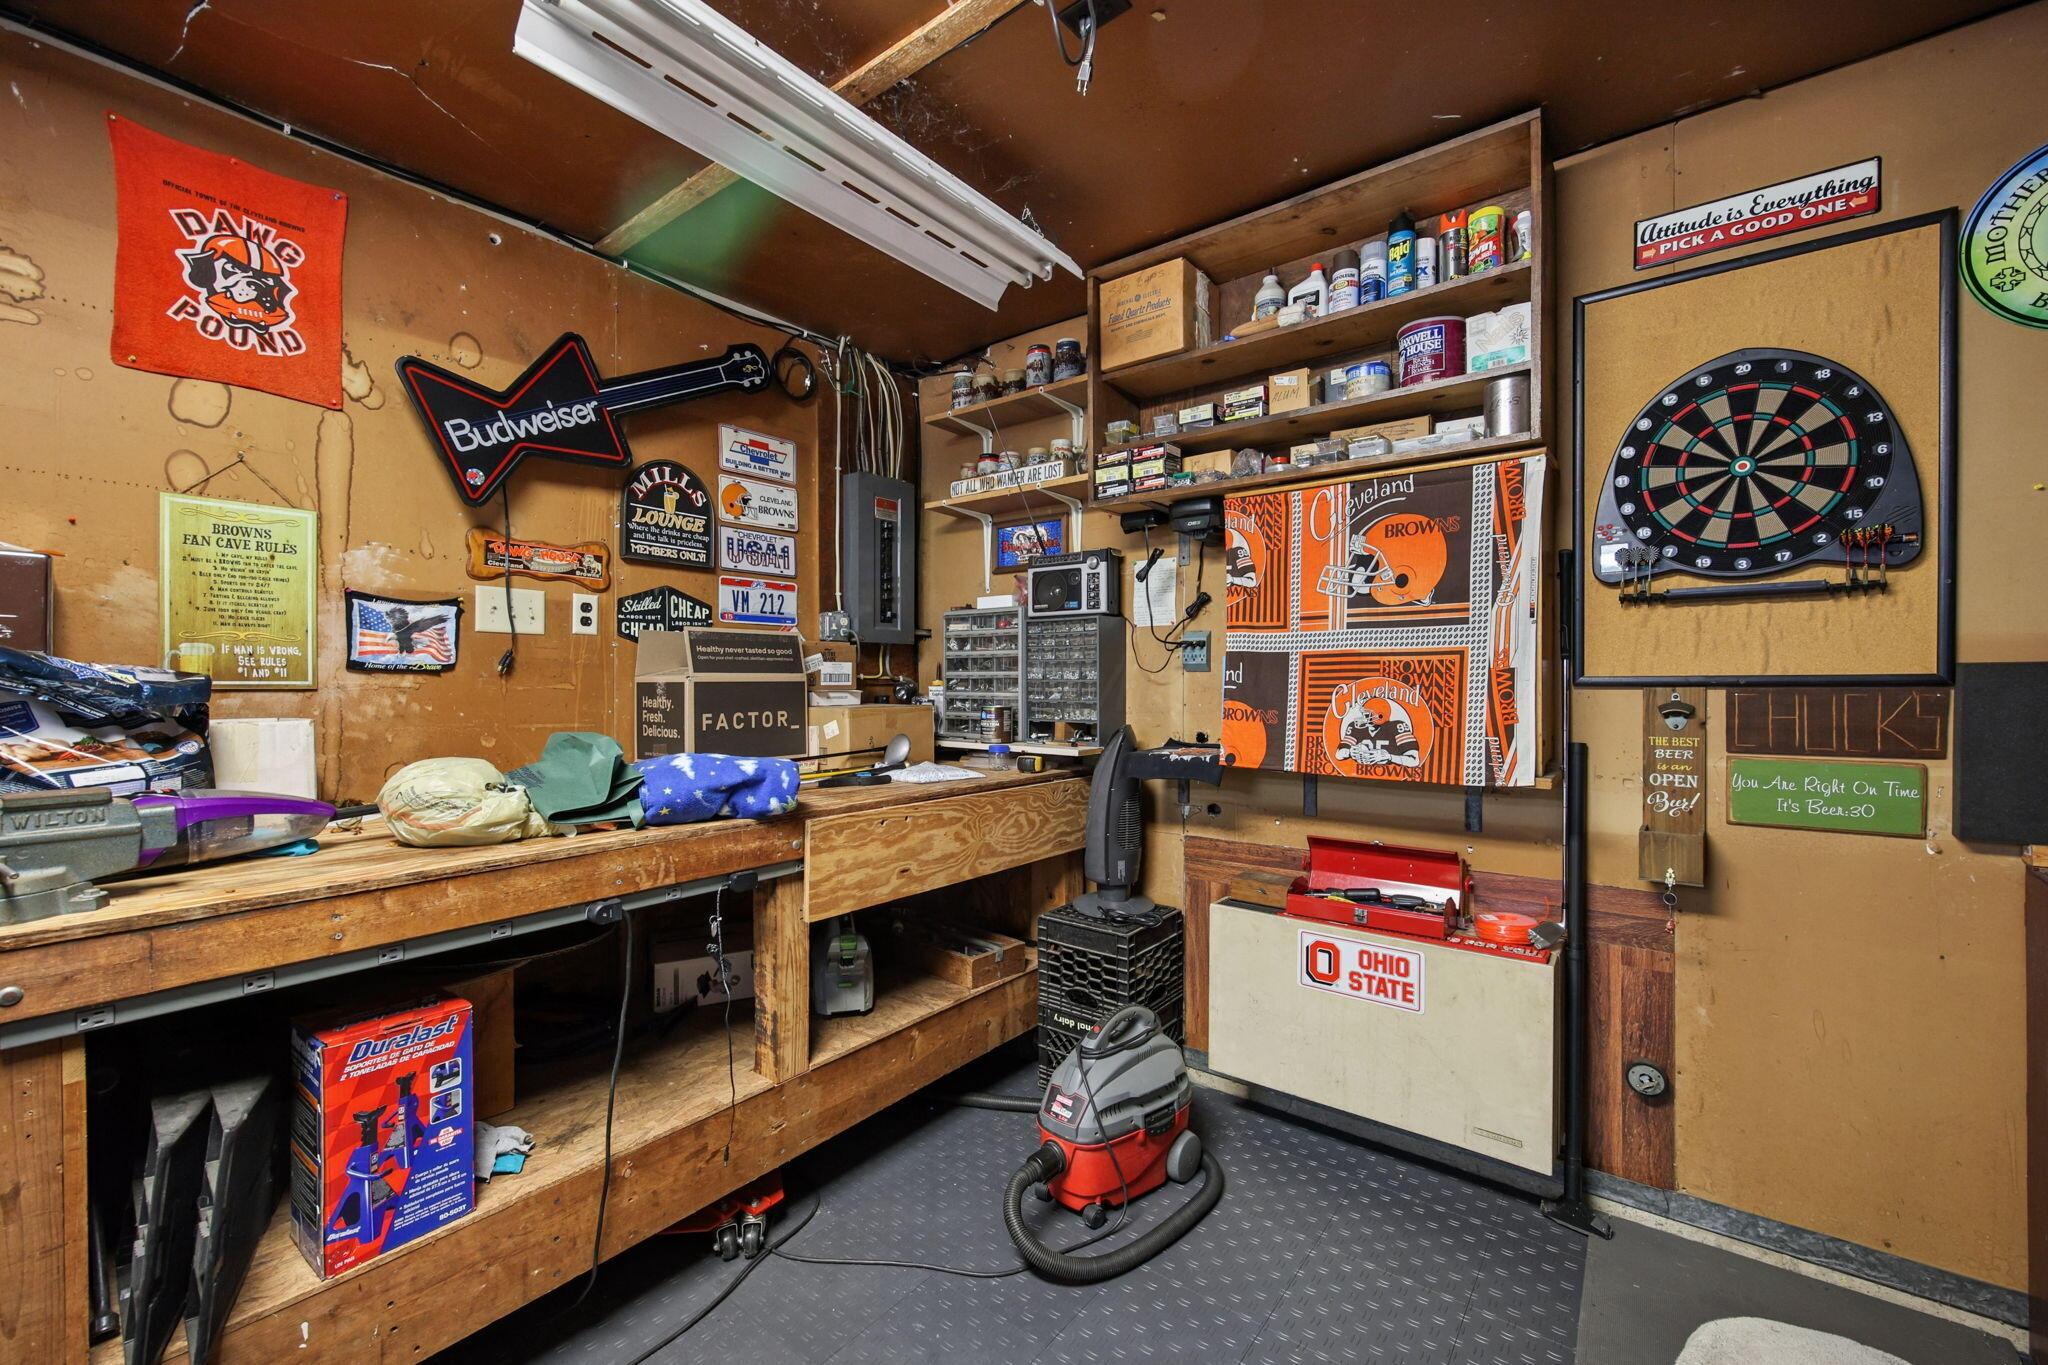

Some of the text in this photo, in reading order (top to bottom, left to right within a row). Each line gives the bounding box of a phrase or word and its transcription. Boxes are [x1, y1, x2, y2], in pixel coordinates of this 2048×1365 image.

[1640, 175, 1875, 244] Attitude is Everything
[1660, 199, 1846, 254] PICK A GOOD ONE
[171, 208, 304, 267] DAWG
[1389, 240, 1410, 261] Raid
[1146, 297, 1171, 312] Products
[168, 297, 305, 356] POUND
[1407, 340, 1441, 356] HOUSE
[1736, 363, 1751, 373] 20
[1781, 362, 1788, 371] 1
[1815, 369, 1831, 379] 18
[1700, 377, 1709, 386] 5
[1849, 387, 1859, 396] 4
[1663, 395, 1677, 405] 12
[1640, 420, 1648, 429] 9
[1867, 412, 1883, 422] 13
[444, 400, 598, 452] Budweiser
[740, 445, 778, 460] Chevrolet
[1621, 448, 1635, 458] 14
[1877, 444, 1887, 454] 6
[725, 458, 751, 469] BUILDING
[758, 465, 779, 475] BETTER
[952, 463, 1062, 495] NOT ALL WHO WANDER ARE LOST
[1617, 478, 1628, 486] 11
[1867, 477, 1884, 487] 10
[630, 467, 707, 507] MILLS
[760, 496, 793, 506] CLEVELAND
[1308, 474, 1416, 542] Cleveland
[1624, 504, 1632, 513] 8
[632, 507, 706, 532] LOUNGE
[759, 506, 794, 519] BROWNS
[1845, 509, 1863, 519] 15
[212, 523, 272, 539] BROWNS
[628, 522, 648, 532] Where
[650, 525, 659, 534] the
[662, 528, 680, 537] drinks
[693, 532, 709, 543] cheap
[1384, 516, 1461, 539] BROWNS
[1637, 529, 1651, 538] 16
[182, 534, 297, 555] FAN CAVE RULES
[646, 533, 656, 541] the
[658, 535, 669, 543] talk
[677, 539, 704, 548] priceless.
[738, 531, 777, 543] CHEVROLET
[1817, 534, 1827, 543] 2
[631, 544, 706, 562] MEMBERS ONLY!
[1666, 547, 1674, 556] 7
[1776, 552, 1791, 562] 17
[1696, 558, 1711, 568] 19
[1738, 560, 1747, 569] 3
[622, 596, 662, 612] Skilled
[670, 595, 709, 619] CHEAP
[732, 590, 784, 615] VM 212
[221, 643, 302, 656] IF MAN IS WRONG,
[696, 646, 724, 654] Healthy
[238, 656, 287, 666] SEE RULES
[1380, 659, 1455, 675] BROWNS
[252, 669, 270, 678] AND
[642, 696, 674, 711] Healthy.
[1332, 681, 1420, 719] Cleveland
[642, 710, 666, 724] Fresh.
[1734, 692, 1942, 752] CHUCKS
[642, 725, 681, 739] Delicious.
[1648, 736, 1700, 747] THE BEST
[1654, 749, 1694, 759] BEER
[1356, 764, 1422, 779] BROWNS
[1649, 773, 1699, 788] OPEN
[1731, 773, 1921, 799] You Are Right On Time
[1647, 791, 1700, 817] Beer!
[1776, 797, 1876, 819] It's Beer:30
[11, 808, 105, 830] WILTON
[1358, 949, 1411, 978] OHIO
[1348, 971, 1414, 1005] STATE
[1053, 1013, 1075, 1028] dairy
[347, 1014, 459, 1065] Duralast
[344, 1040, 435, 1073] SOPORTES DE GATO DE
[350, 1058, 399, 1078] TONELADAS
[400, 1054, 409, 1062] DE
[412, 1040, 455, 1059] CAPACIDAD
[326, 1225, 361, 1241] Duralast
